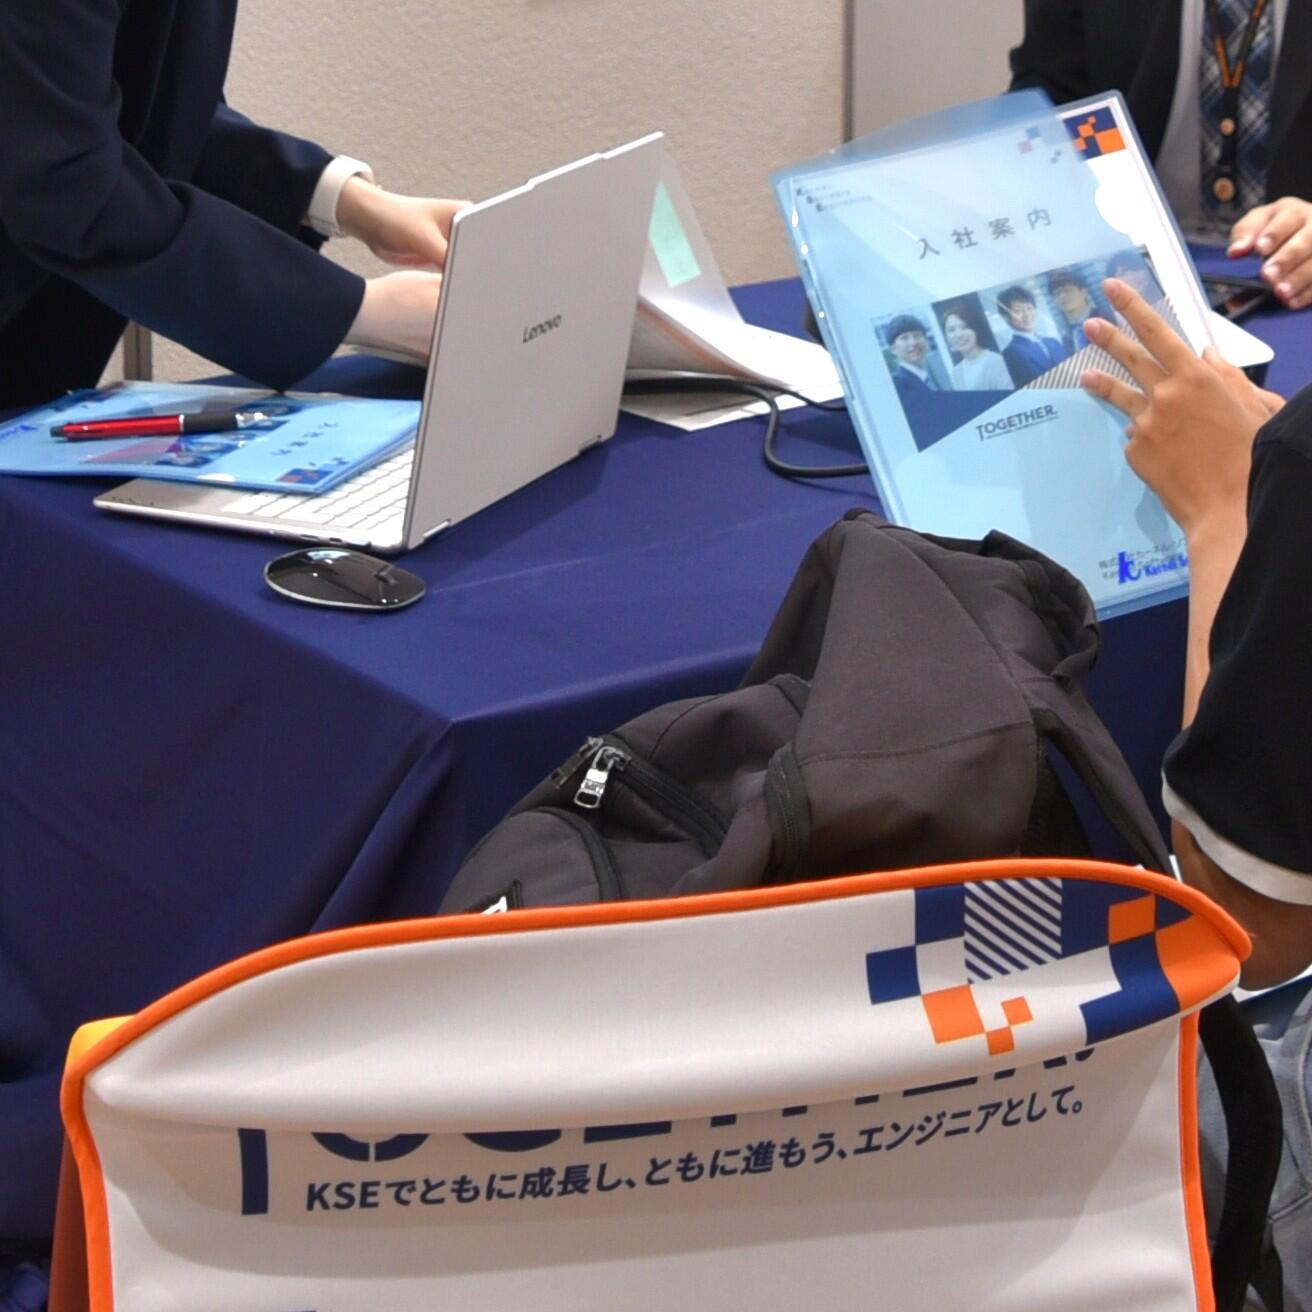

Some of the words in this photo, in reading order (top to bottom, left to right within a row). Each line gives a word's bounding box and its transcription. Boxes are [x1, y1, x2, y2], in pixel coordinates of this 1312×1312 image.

[917, 207, 1053, 260] 入社案内
[522, 314, 562, 344] Lenovo
